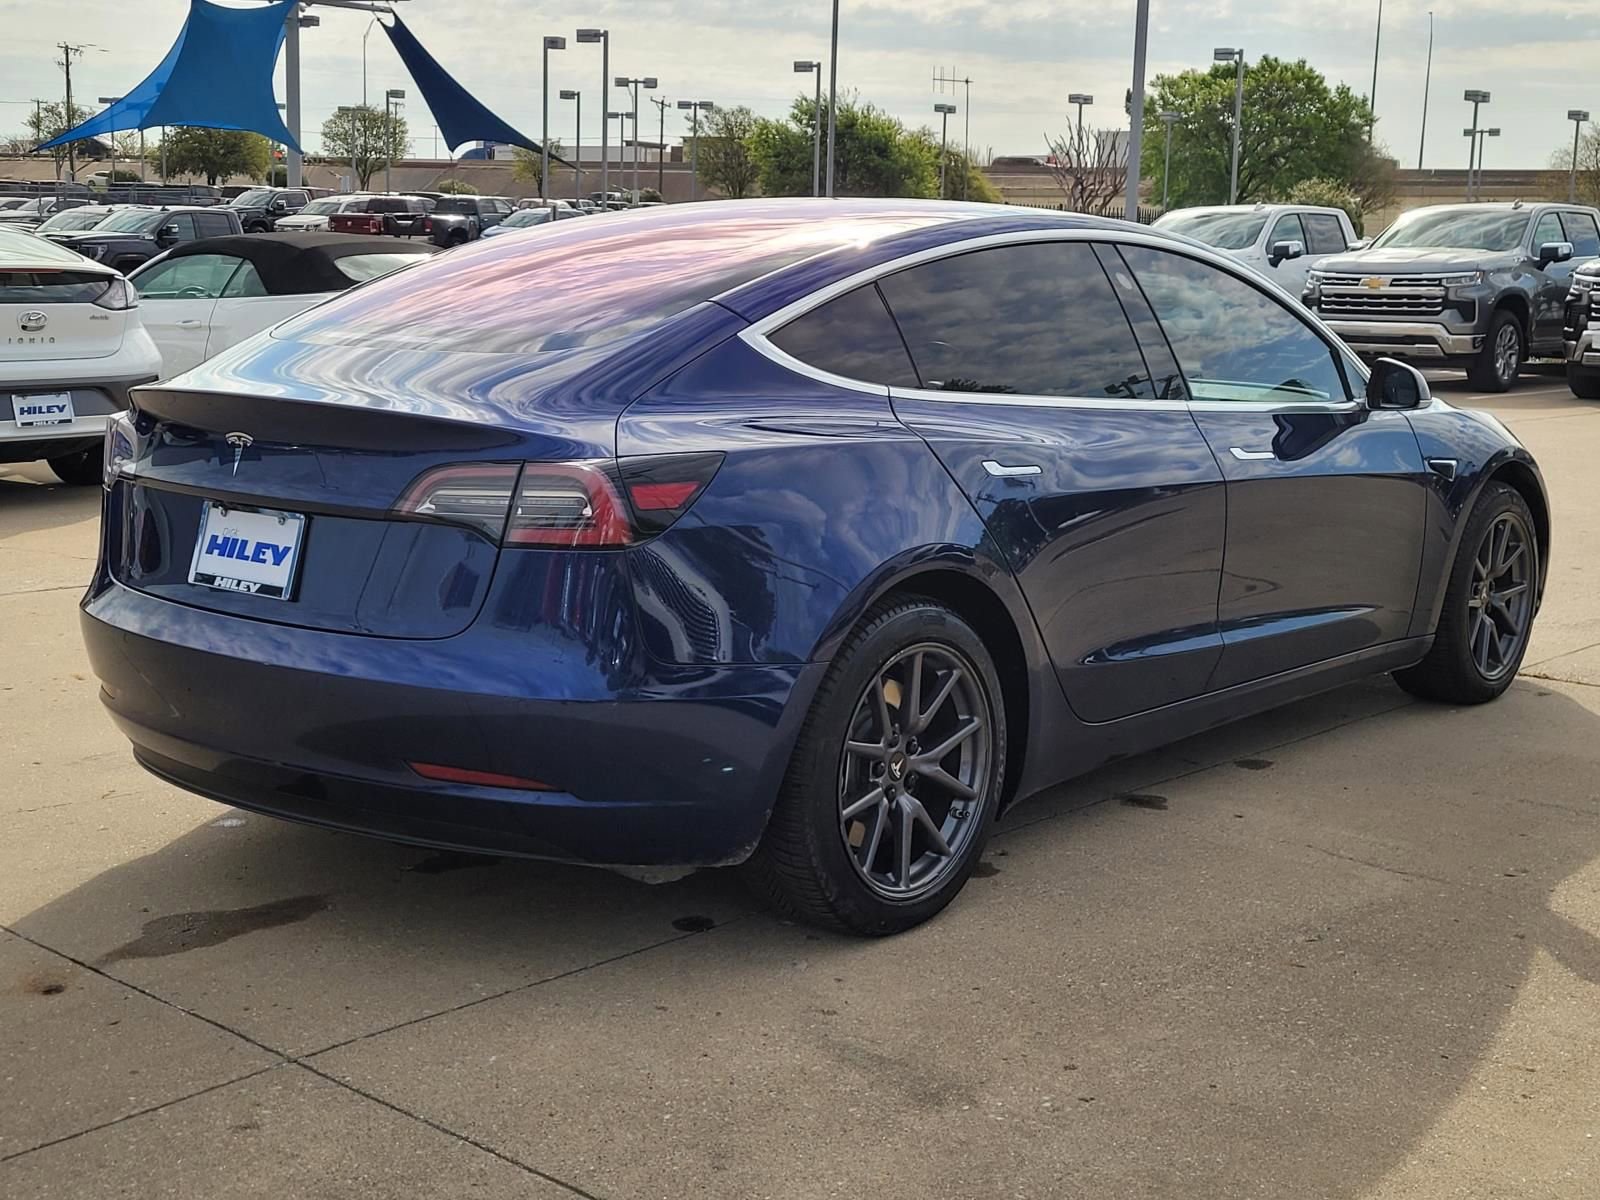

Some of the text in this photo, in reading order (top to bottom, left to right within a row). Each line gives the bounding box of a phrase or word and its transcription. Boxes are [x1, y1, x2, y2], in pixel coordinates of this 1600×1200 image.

[19, 404, 66, 415] HILEY
[205, 534, 292, 567] HILEY
[213, 576, 261, 593] HILEY
